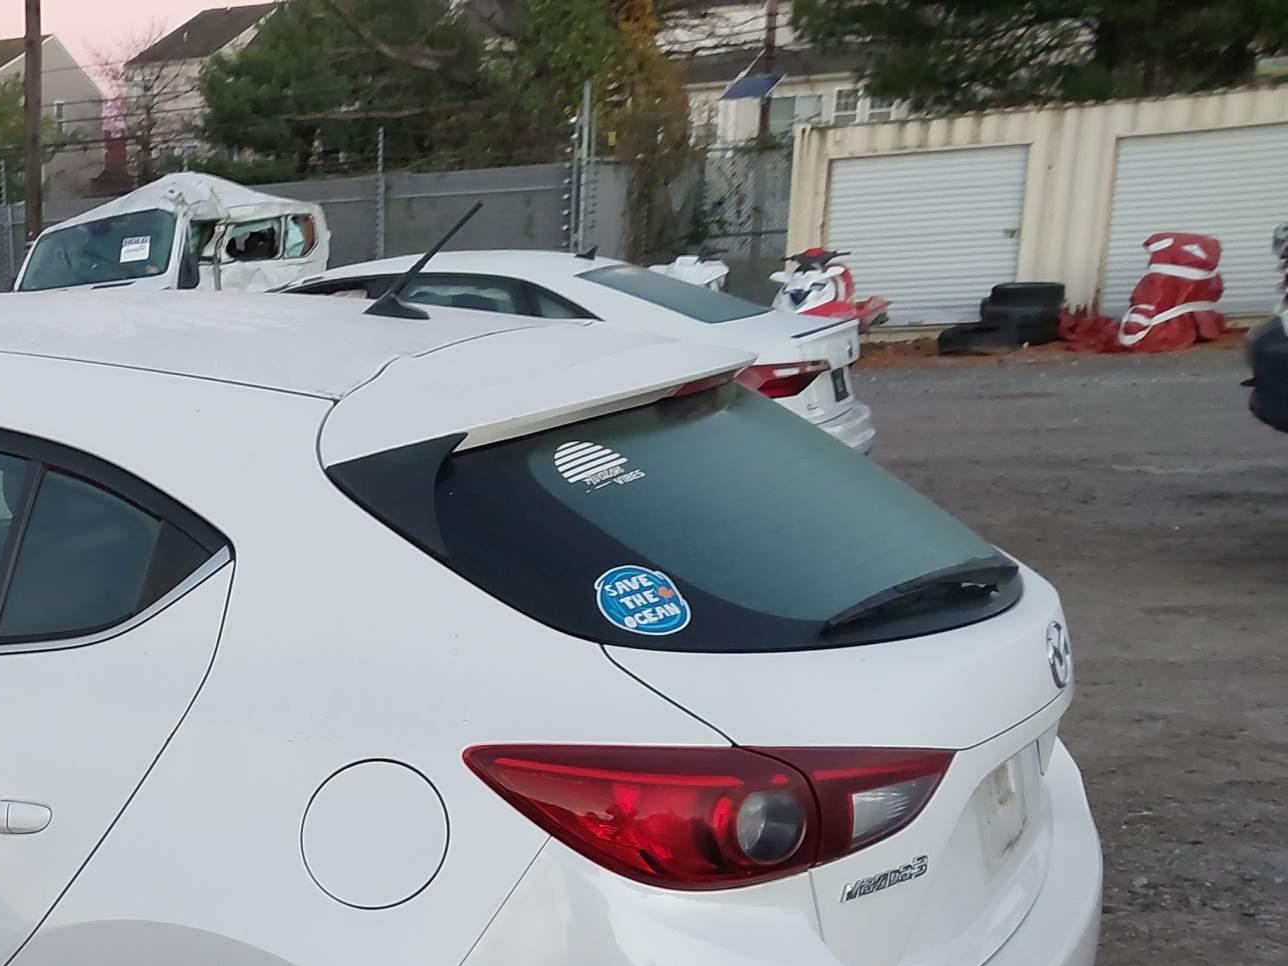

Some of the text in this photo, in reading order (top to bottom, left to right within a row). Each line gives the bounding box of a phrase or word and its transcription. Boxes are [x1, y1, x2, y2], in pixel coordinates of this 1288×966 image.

[604, 574, 654, 597] SAVE
[619, 588, 660, 610] THE
[623, 602, 681, 629] OCEAN
